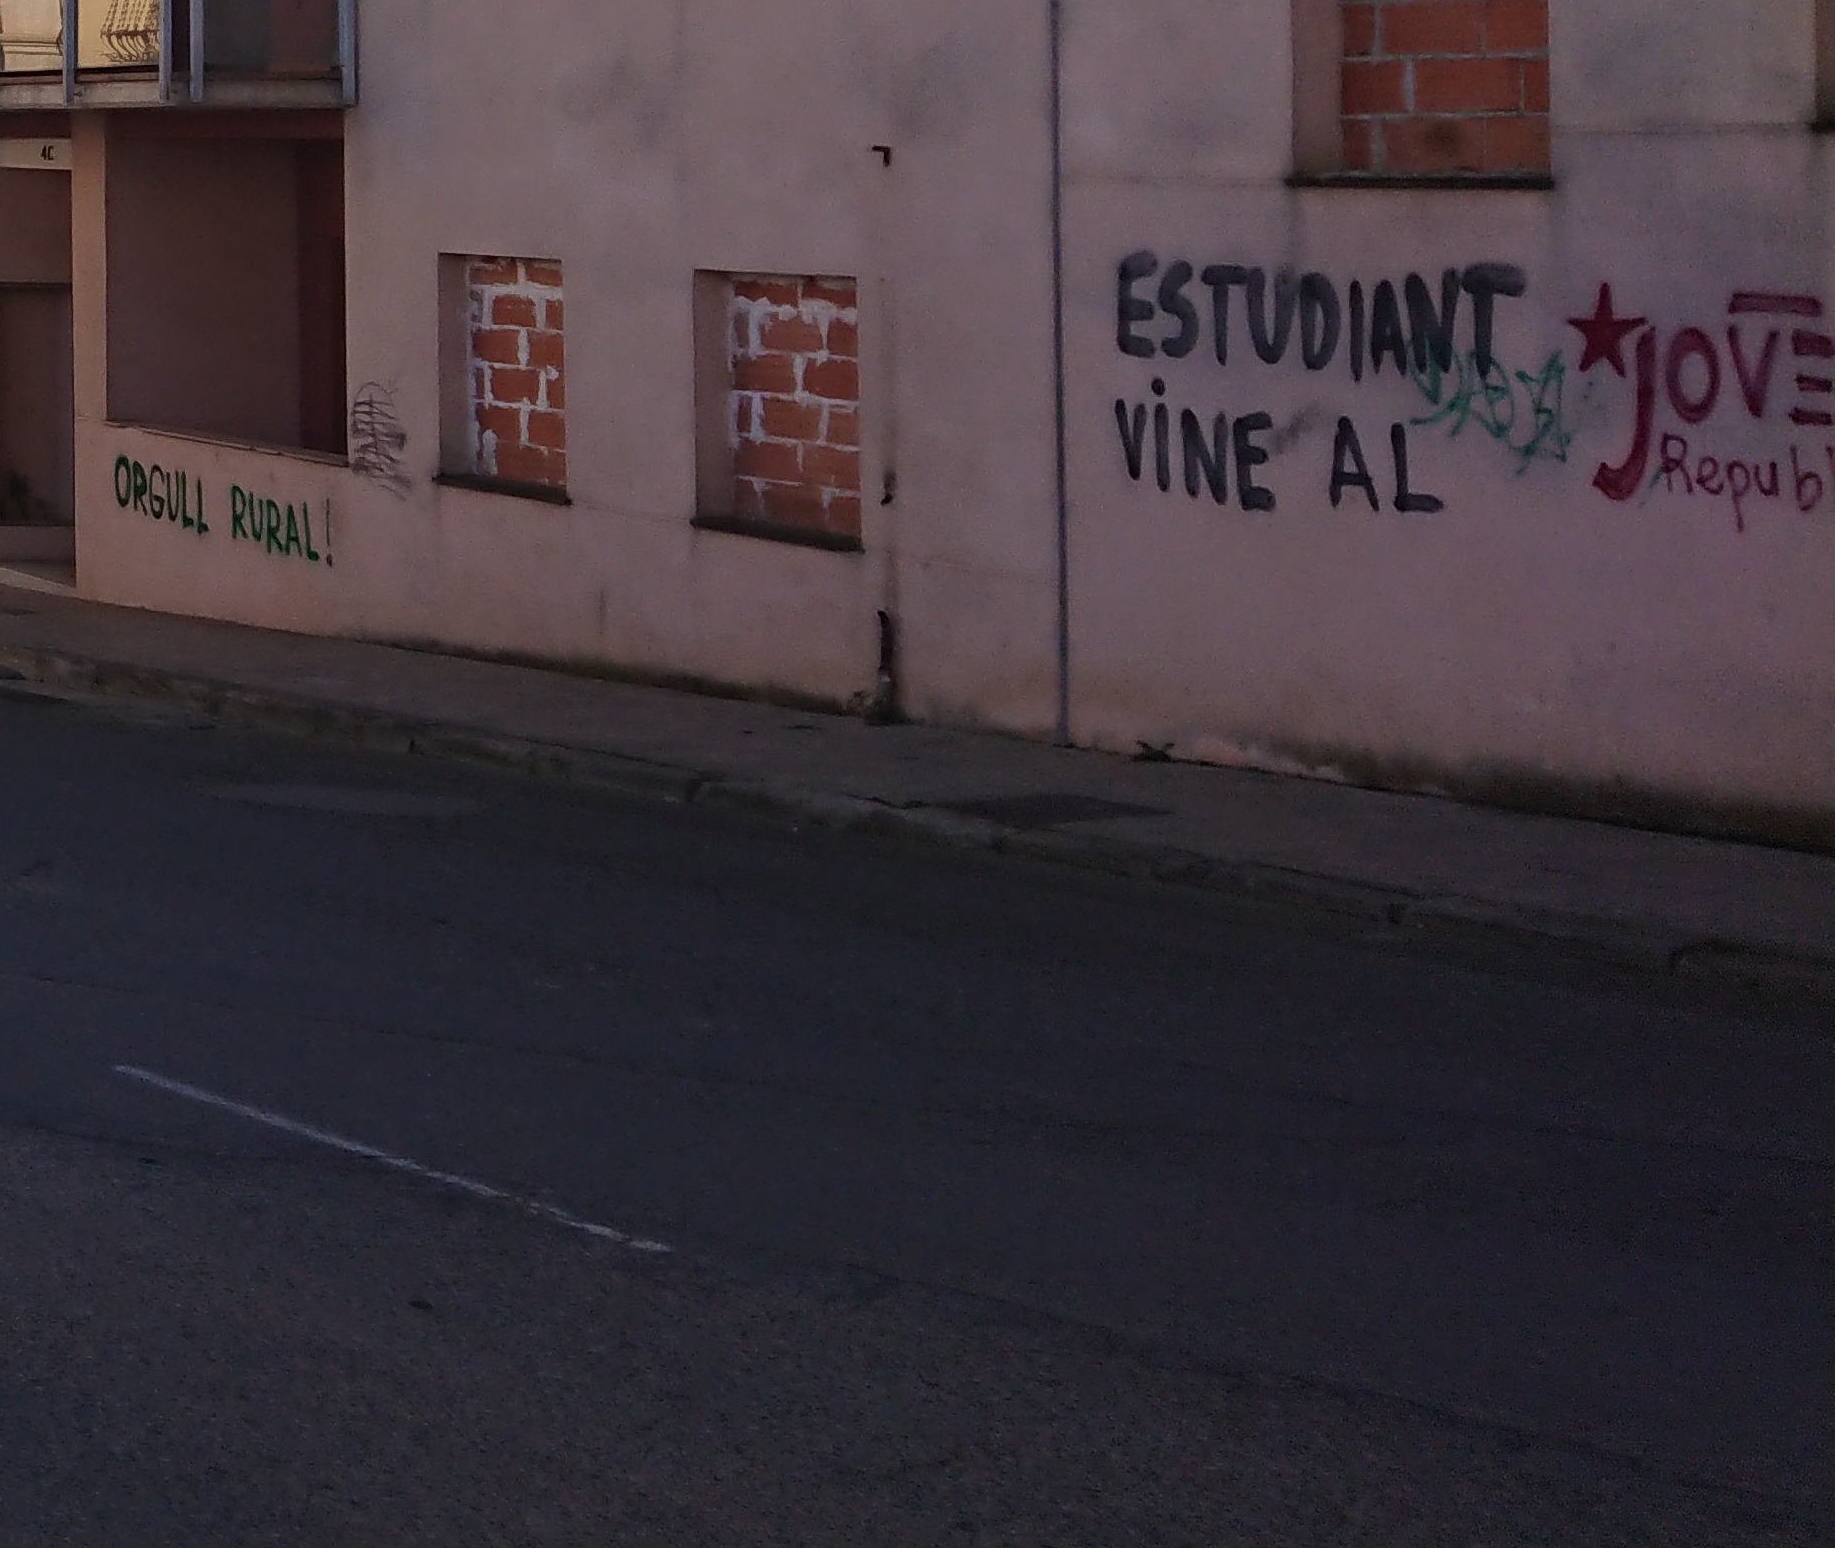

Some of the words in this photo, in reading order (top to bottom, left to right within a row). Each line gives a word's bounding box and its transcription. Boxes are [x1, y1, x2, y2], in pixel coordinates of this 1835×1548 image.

[1116, 249, 1528, 382] ESTUDIANT
[115, 454, 209, 536] ORGULL
[230, 484, 334, 567] RURAL!
[1328, 415, 1444, 513] AL
